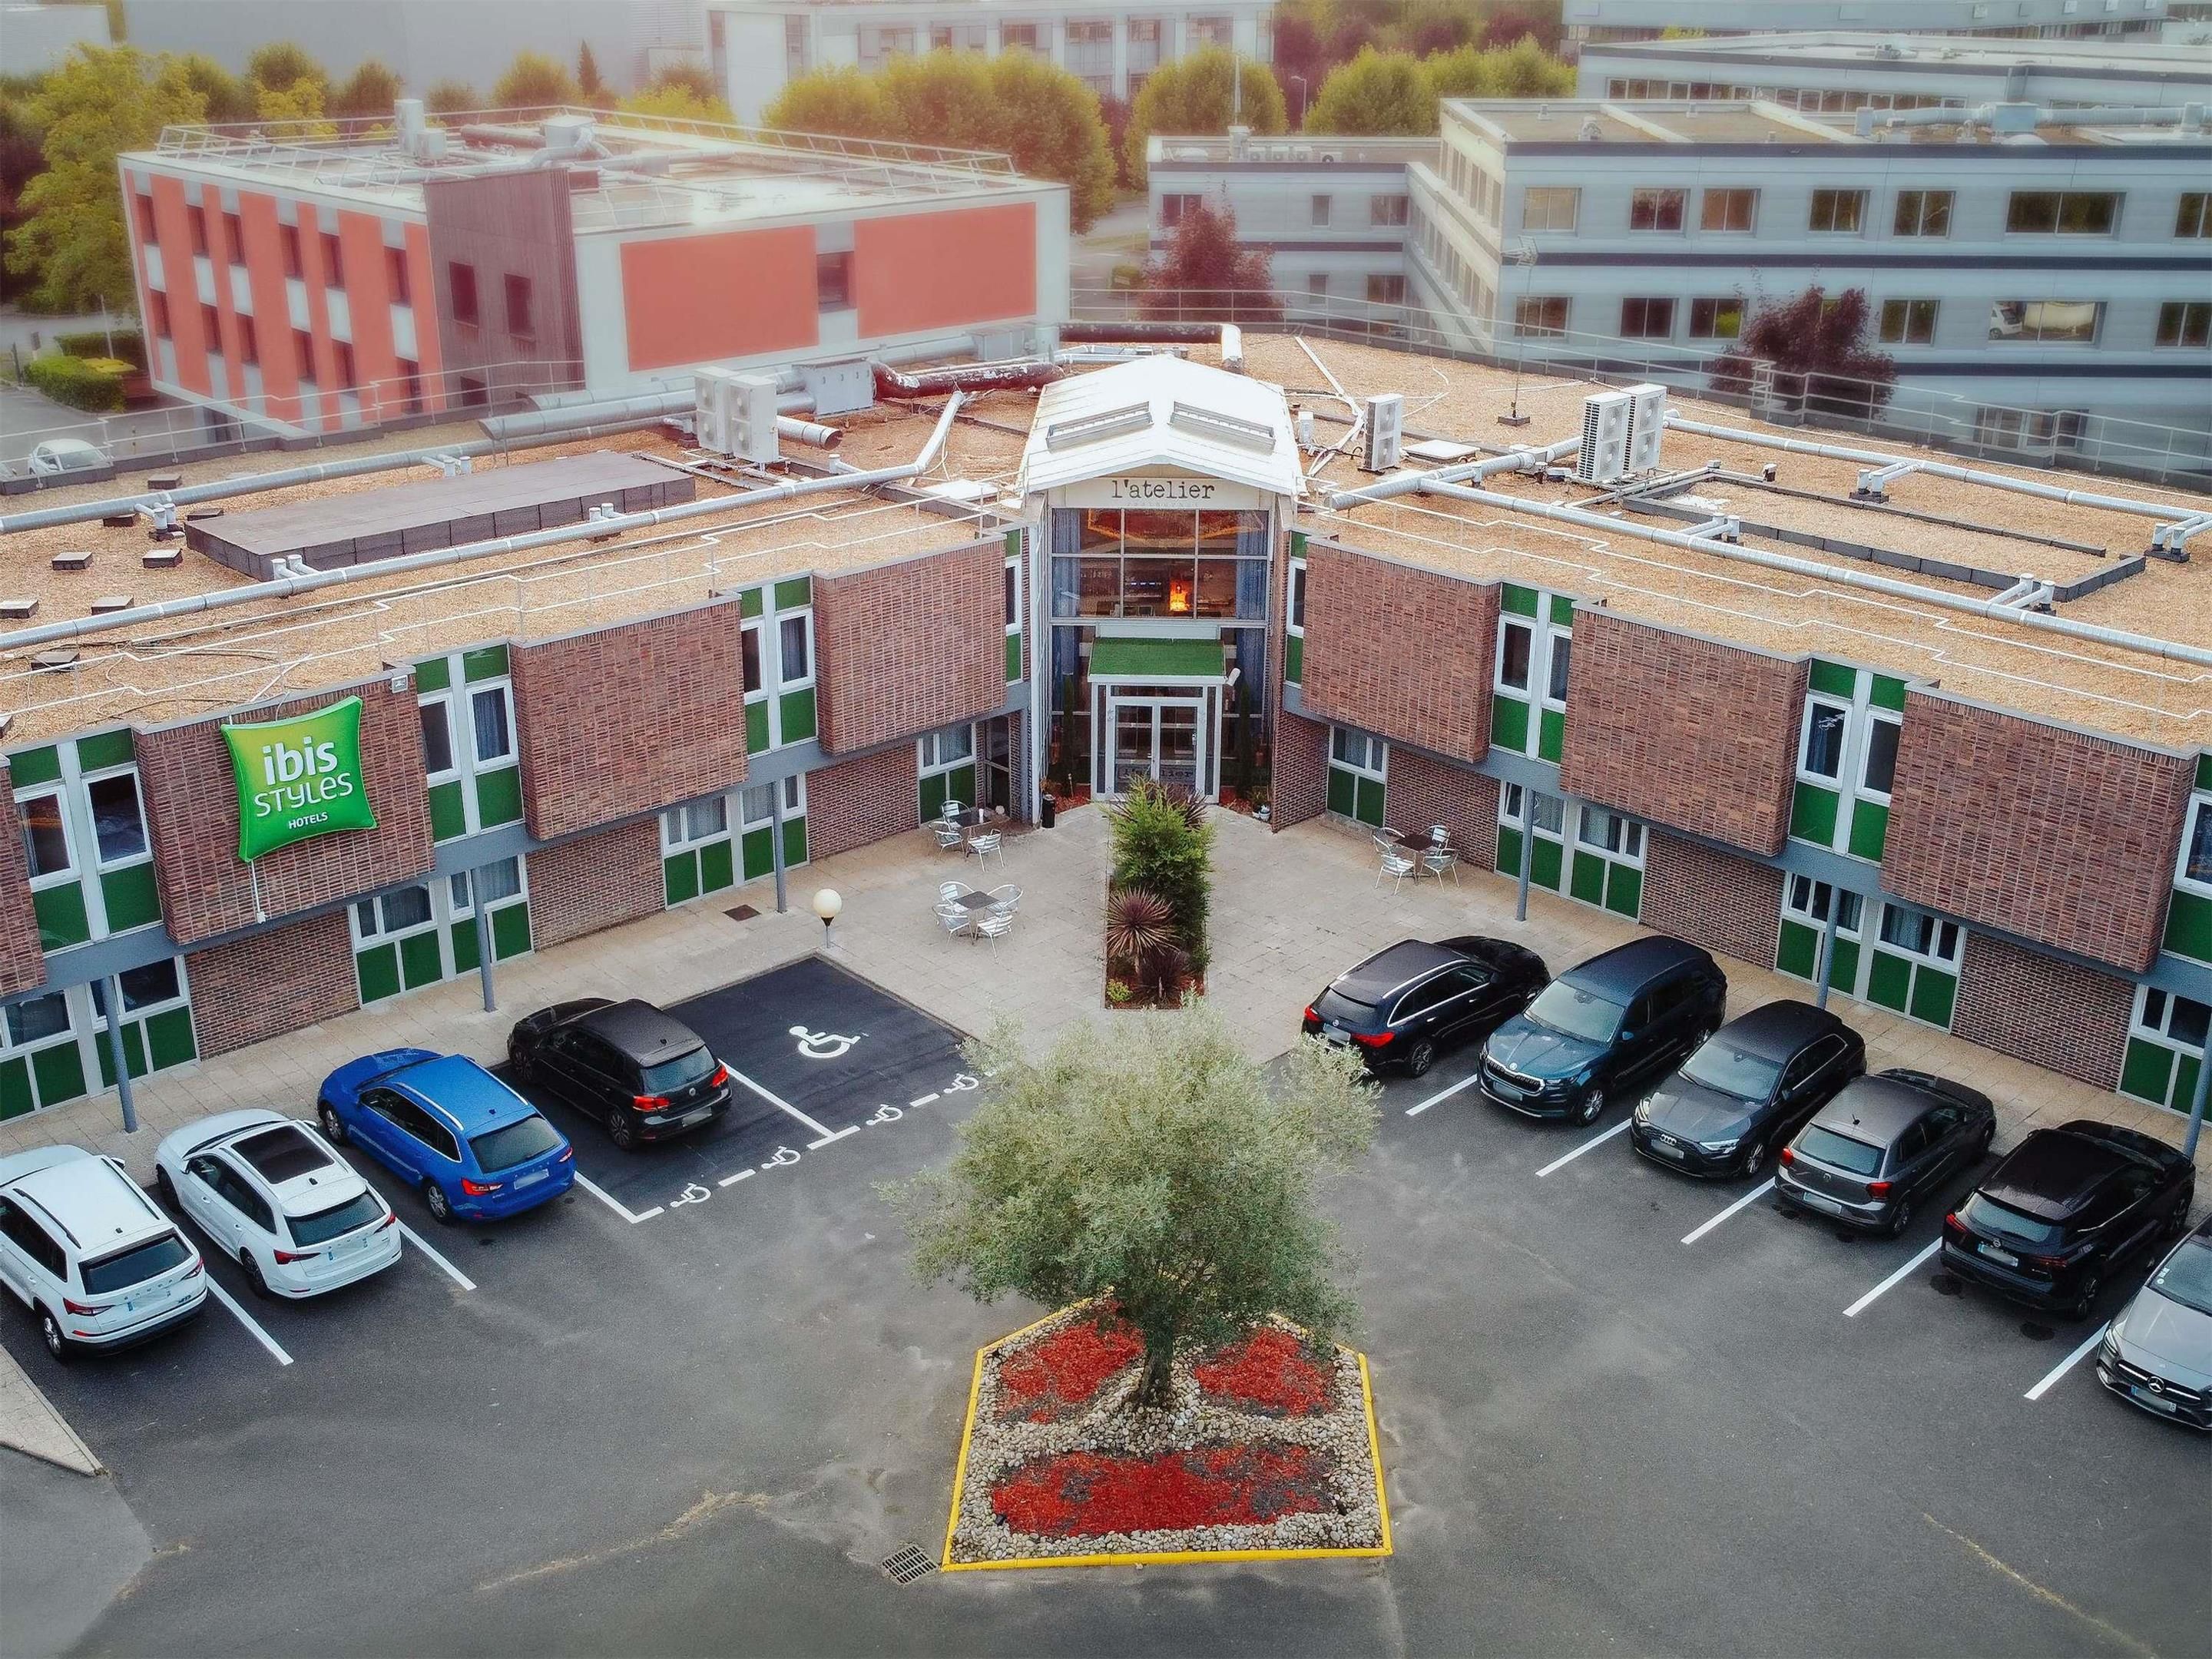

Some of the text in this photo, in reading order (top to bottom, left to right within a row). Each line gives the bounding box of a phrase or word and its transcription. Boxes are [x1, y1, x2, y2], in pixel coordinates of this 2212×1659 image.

[1111, 478, 1215, 499] l'atelier
[262, 736, 338, 786] ibis
[288, 811, 329, 830] HOTELS
